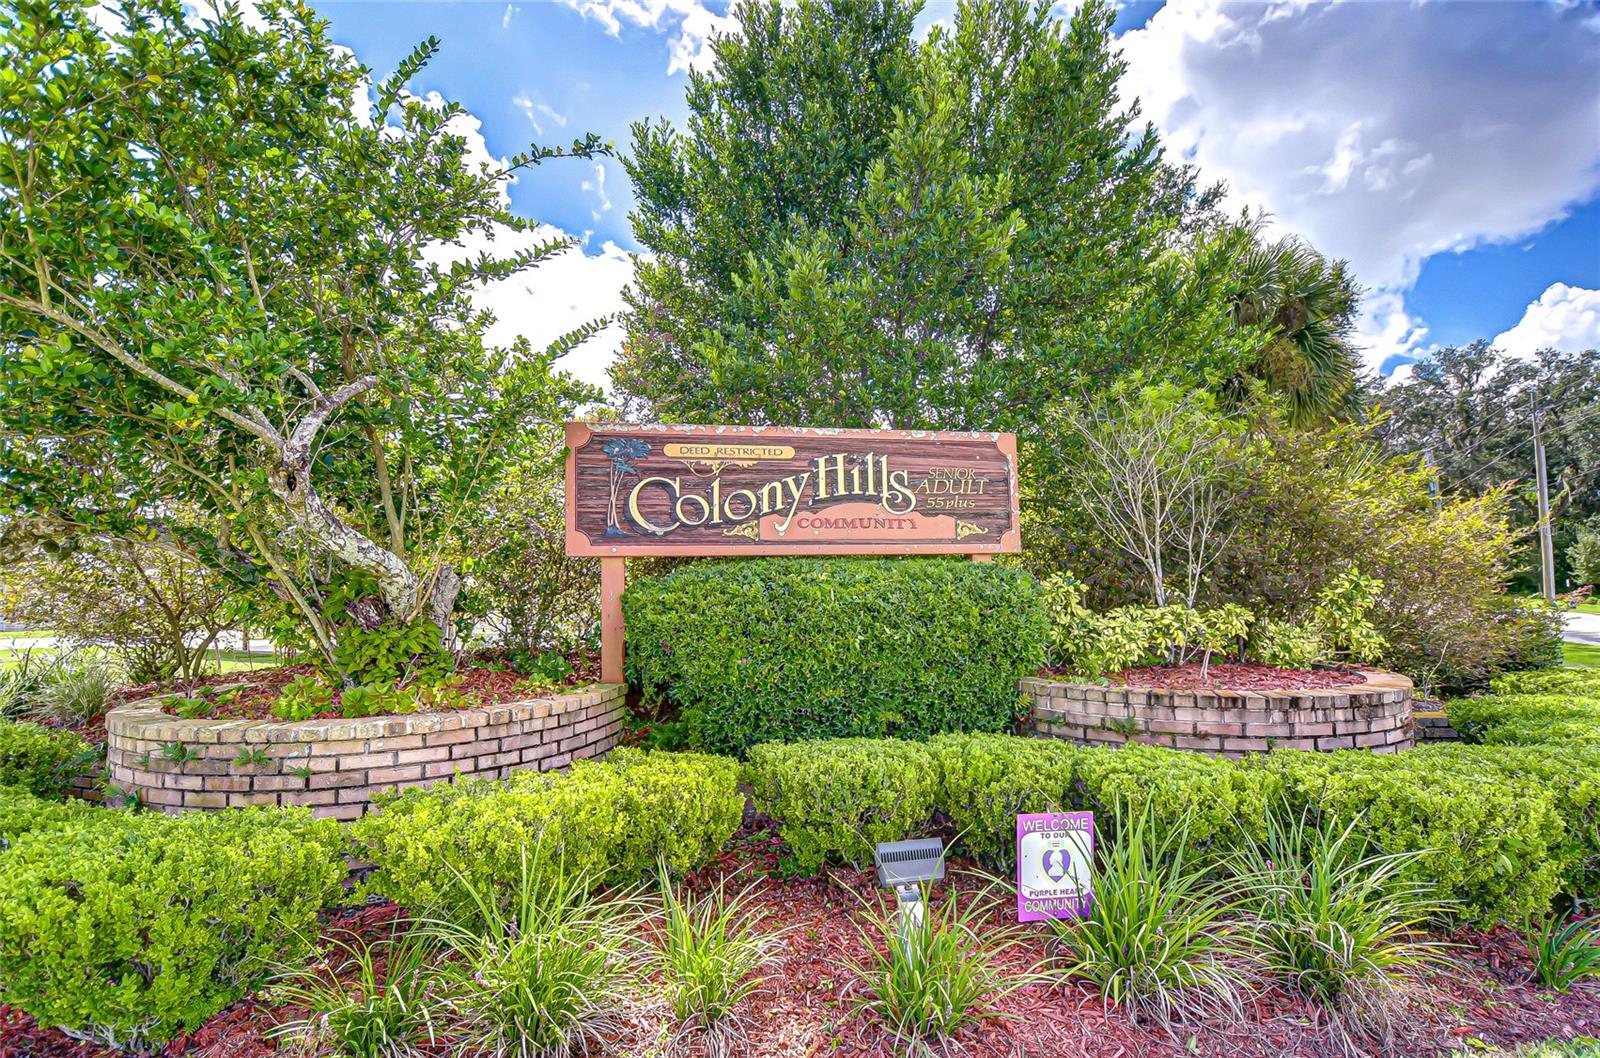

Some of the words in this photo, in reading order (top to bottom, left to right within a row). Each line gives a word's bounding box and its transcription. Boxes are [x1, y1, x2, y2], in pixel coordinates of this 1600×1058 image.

[679, 446, 710, 455] DEED
[716, 446, 783, 456] RESTRICTED
[928, 466, 976, 480] SENIOR
[914, 477, 989, 495] ADULT
[629, 472, 812, 536] Colony
[815, 451, 917, 515] Hills
[797, 517, 918, 530] COMMUNITY
[1022, 818, 1089, 832] WELCOME
[1029, 889, 1059, 897] PURPLE
[1024, 897, 1088, 913] COMMUNITY
